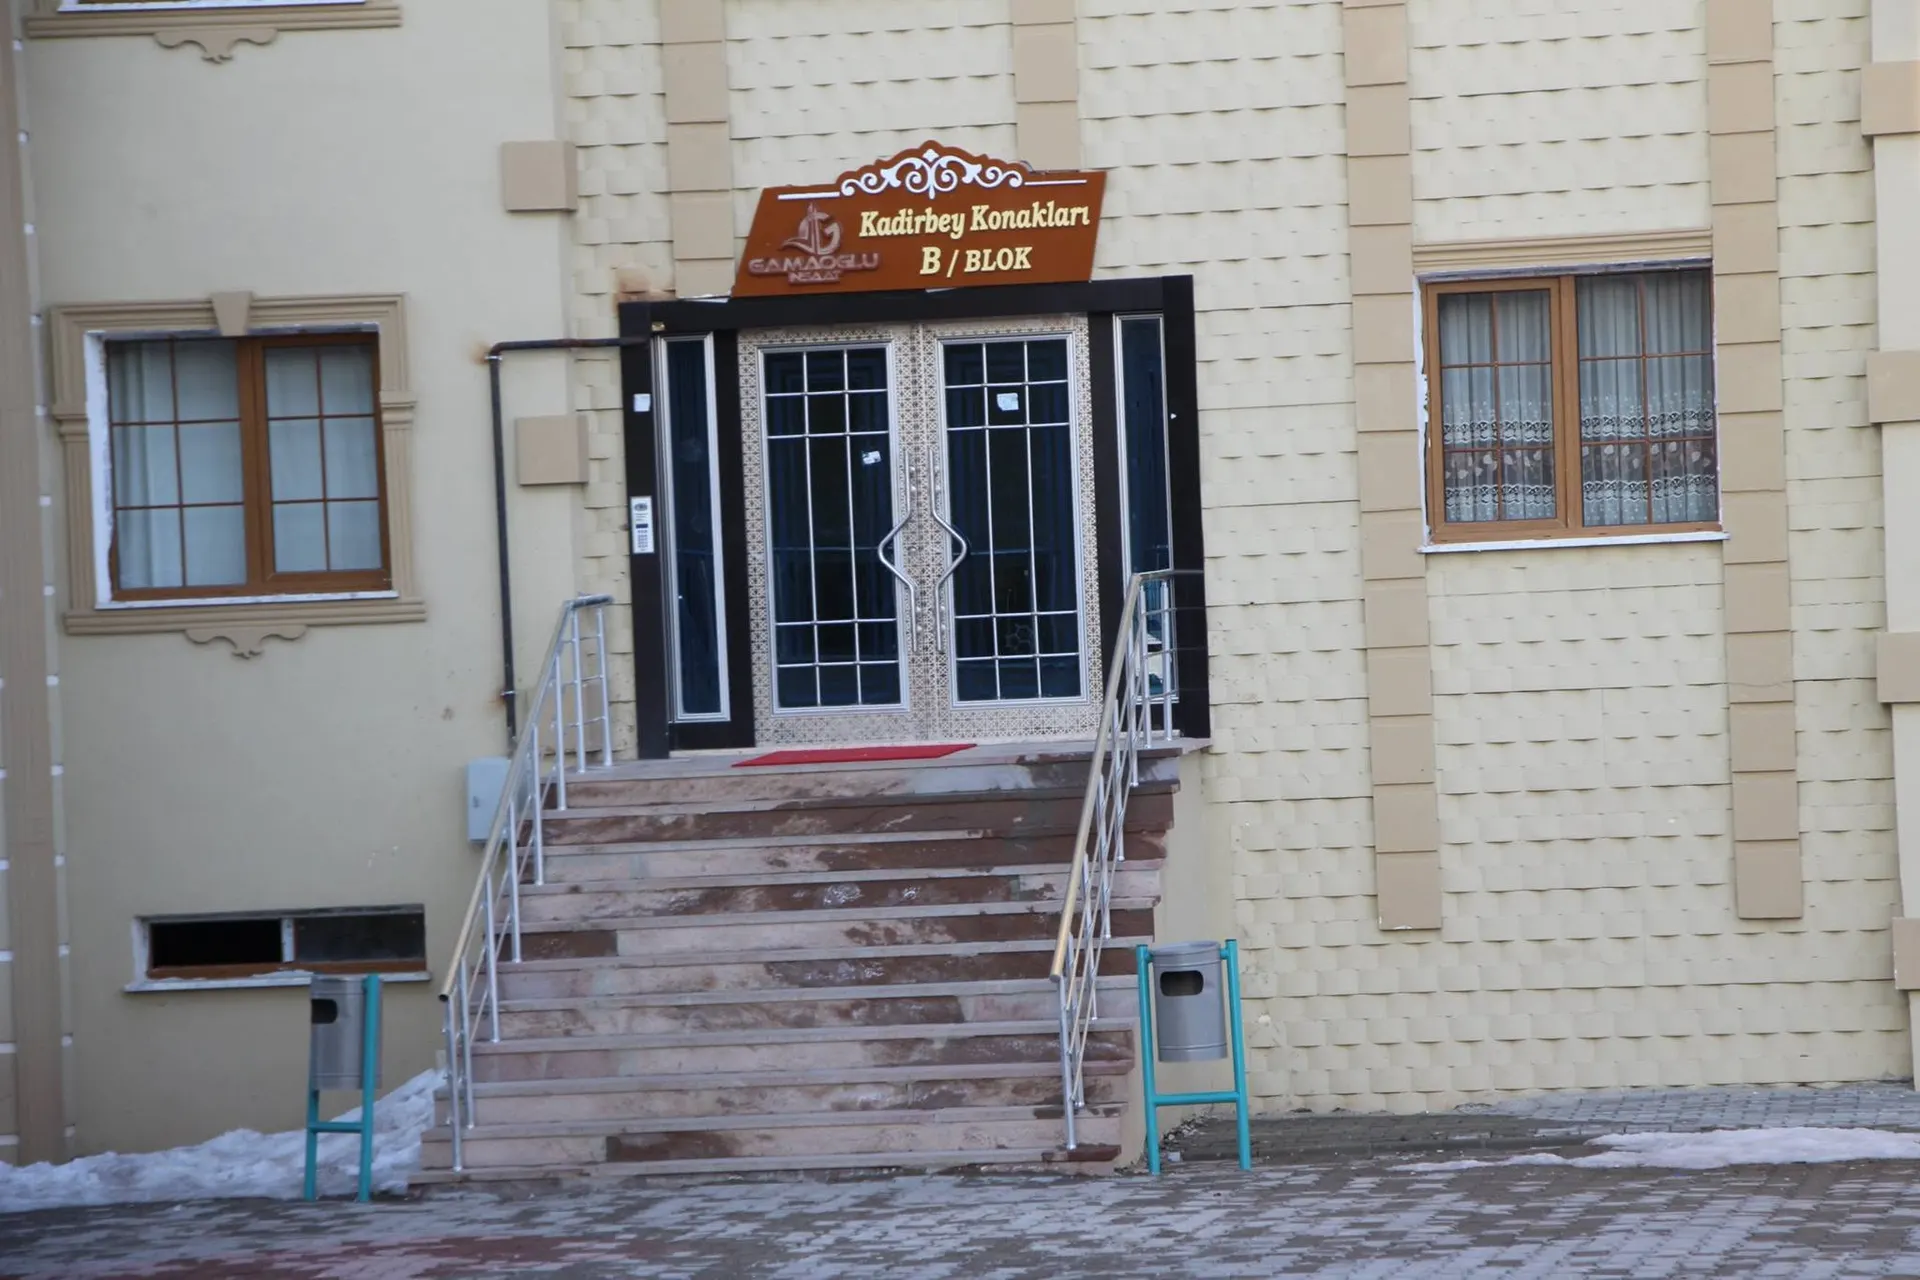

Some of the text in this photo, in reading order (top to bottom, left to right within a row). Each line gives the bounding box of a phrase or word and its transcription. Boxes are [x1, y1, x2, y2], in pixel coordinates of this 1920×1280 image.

[858, 200, 1092, 240] Kadirbey Konakları
[920, 246, 1033, 278] B / BLOK
